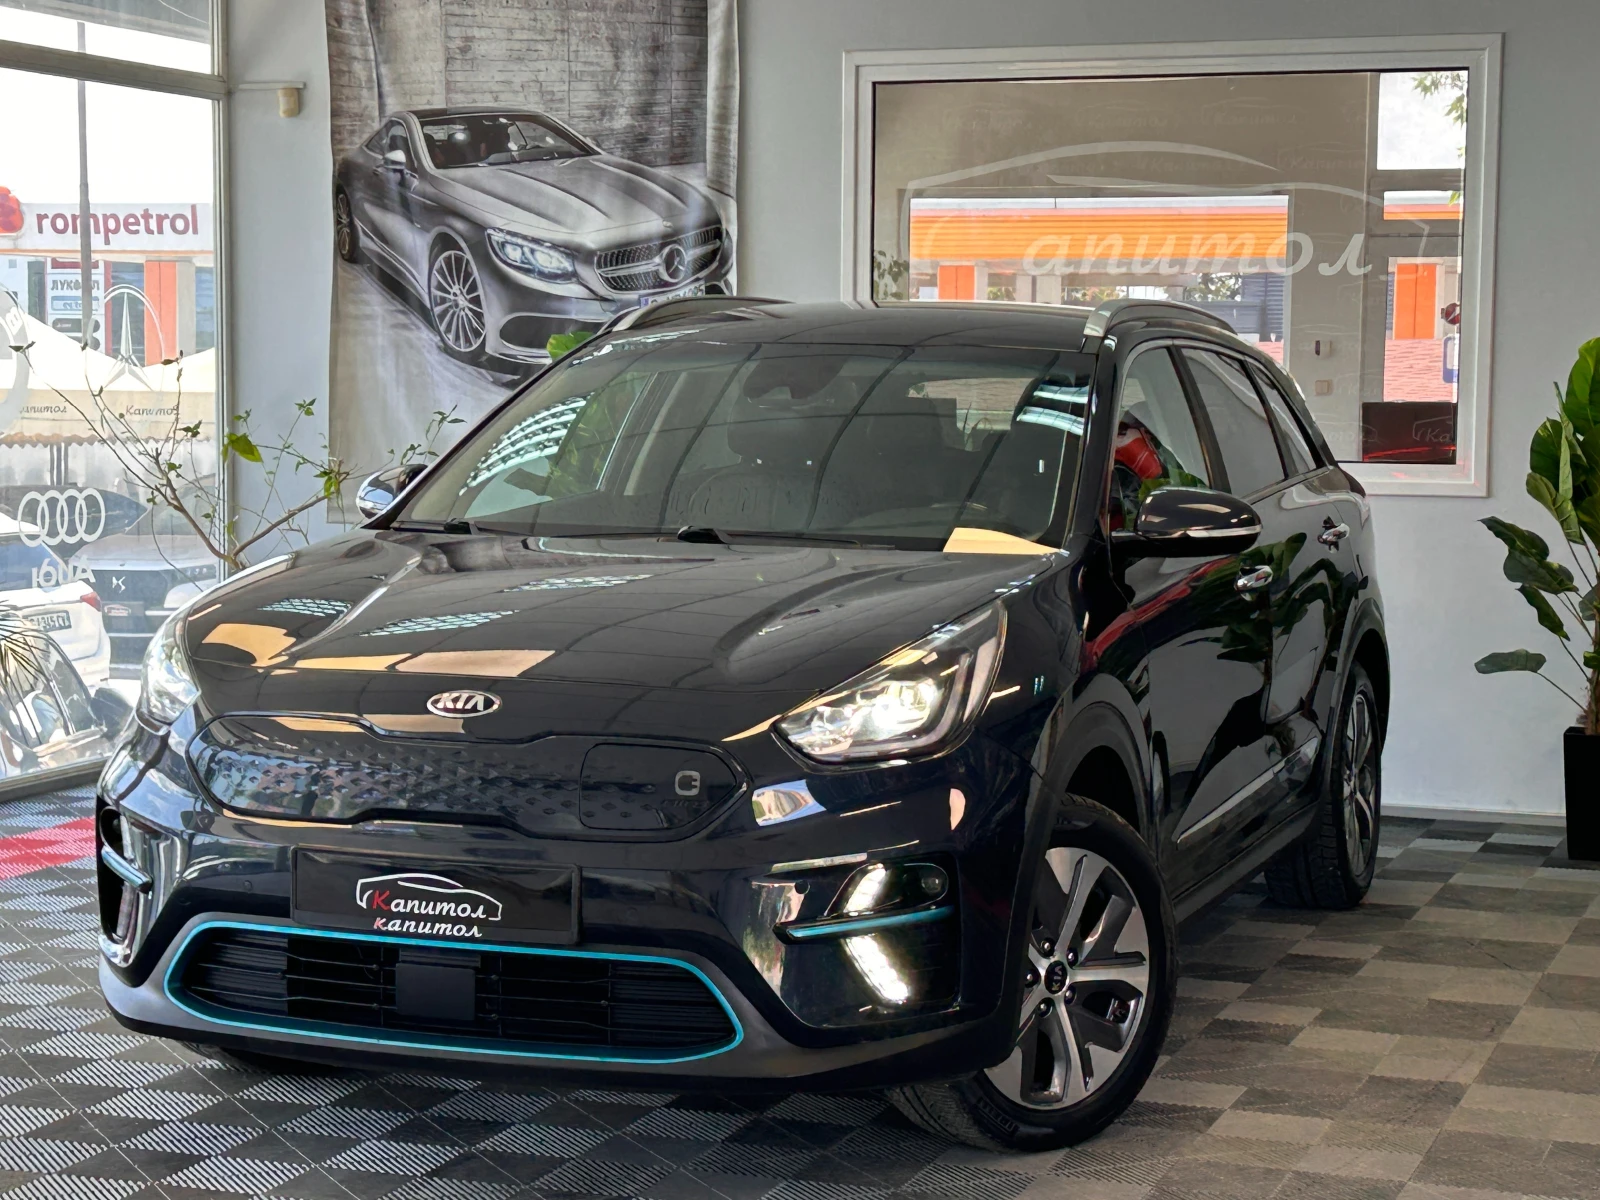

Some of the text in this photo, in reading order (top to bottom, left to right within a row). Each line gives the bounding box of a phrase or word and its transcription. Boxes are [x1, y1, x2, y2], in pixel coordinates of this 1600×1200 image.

[36, 204, 199, 245] rompetrol
[51, 279, 100, 291] ЛУКОЛ
[436, 692, 485, 711] KIA
[372, 890, 487, 919] Капитол
[373, 917, 483, 938] капитол
